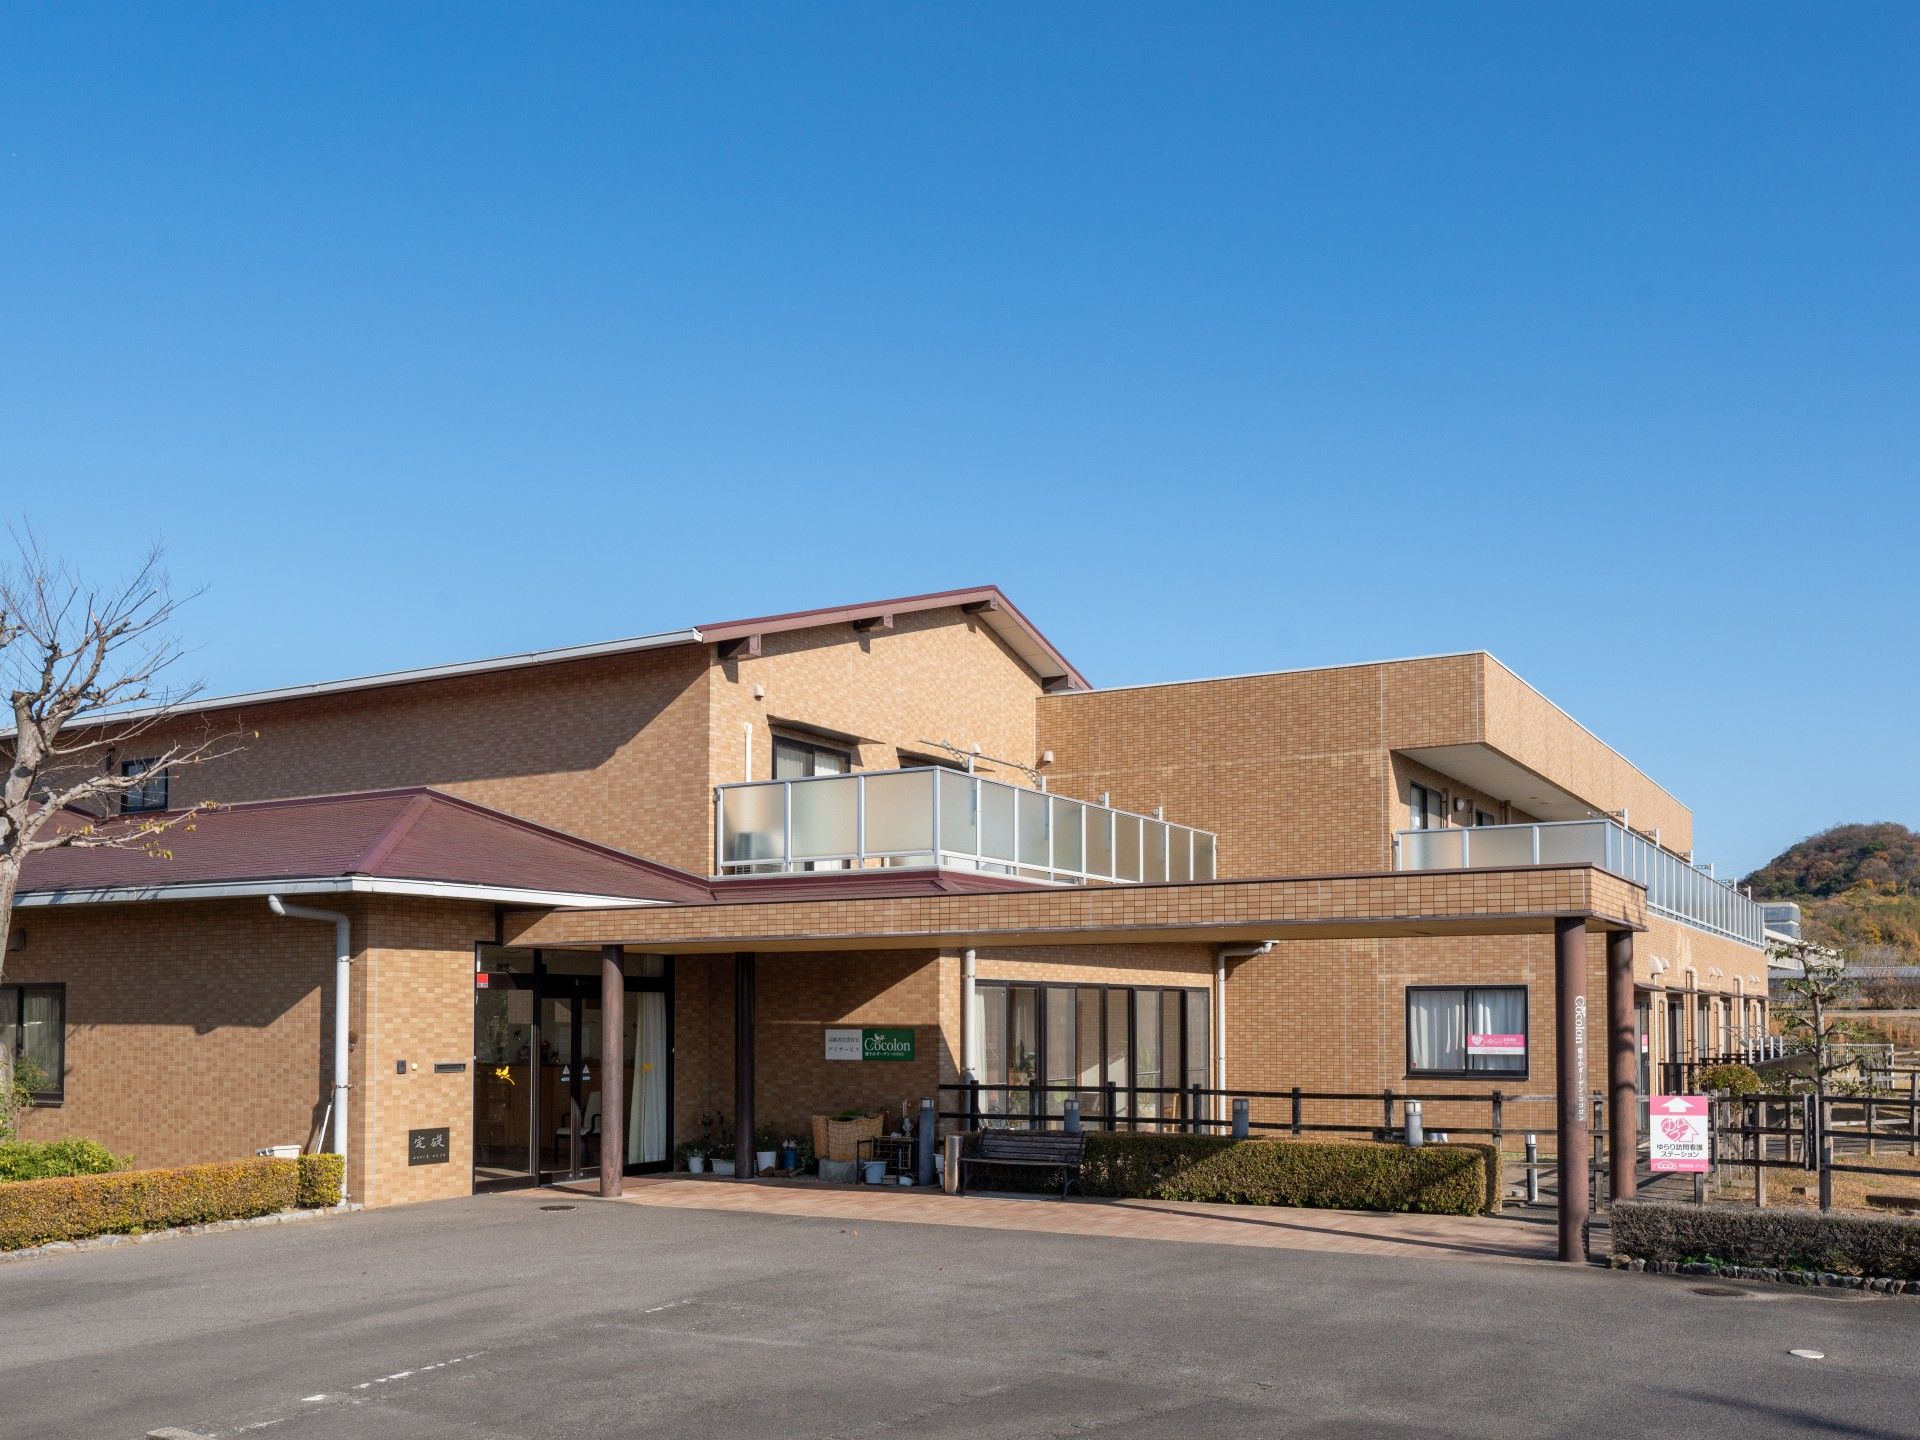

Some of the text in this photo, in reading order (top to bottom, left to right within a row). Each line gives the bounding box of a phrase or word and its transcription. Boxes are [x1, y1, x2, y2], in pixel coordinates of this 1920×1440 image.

[1575, 995, 1585, 1044] Cocolon
[864, 1037, 910, 1051] Cocolon
[1656, 1143, 1703, 1151] ゆらり訪問看護
